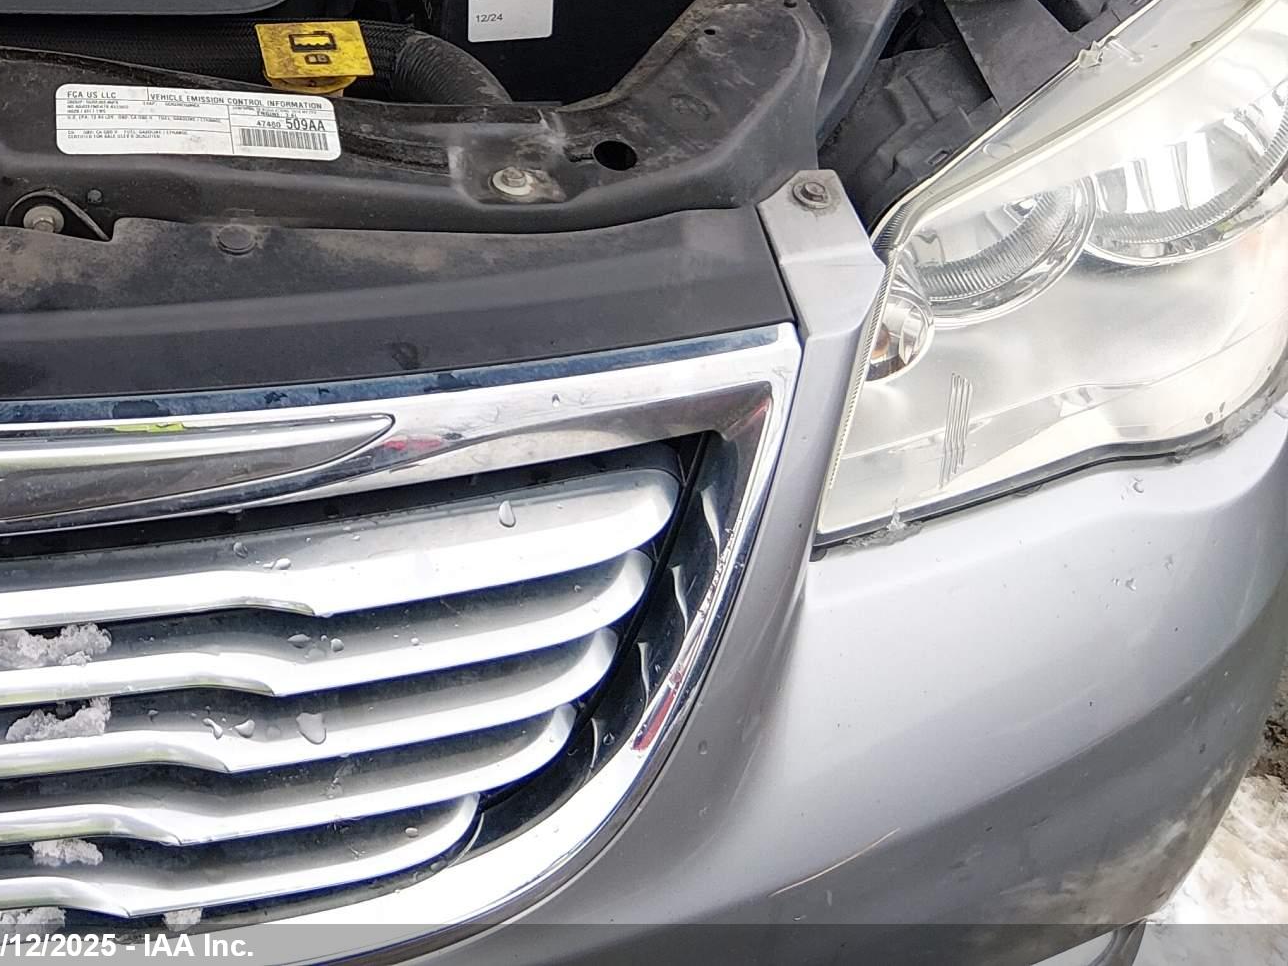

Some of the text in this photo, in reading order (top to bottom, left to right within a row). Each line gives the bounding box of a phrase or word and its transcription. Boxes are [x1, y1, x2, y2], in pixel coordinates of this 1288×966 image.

[476, 13, 503, 23] 12/24
[67, 91, 83, 99] FCA
[86, 91, 98, 99] US
[150, 93, 322, 109] VEHICLE EMISSION CONTROL INFORMATION
[285, 118, 326, 131] 509AA
